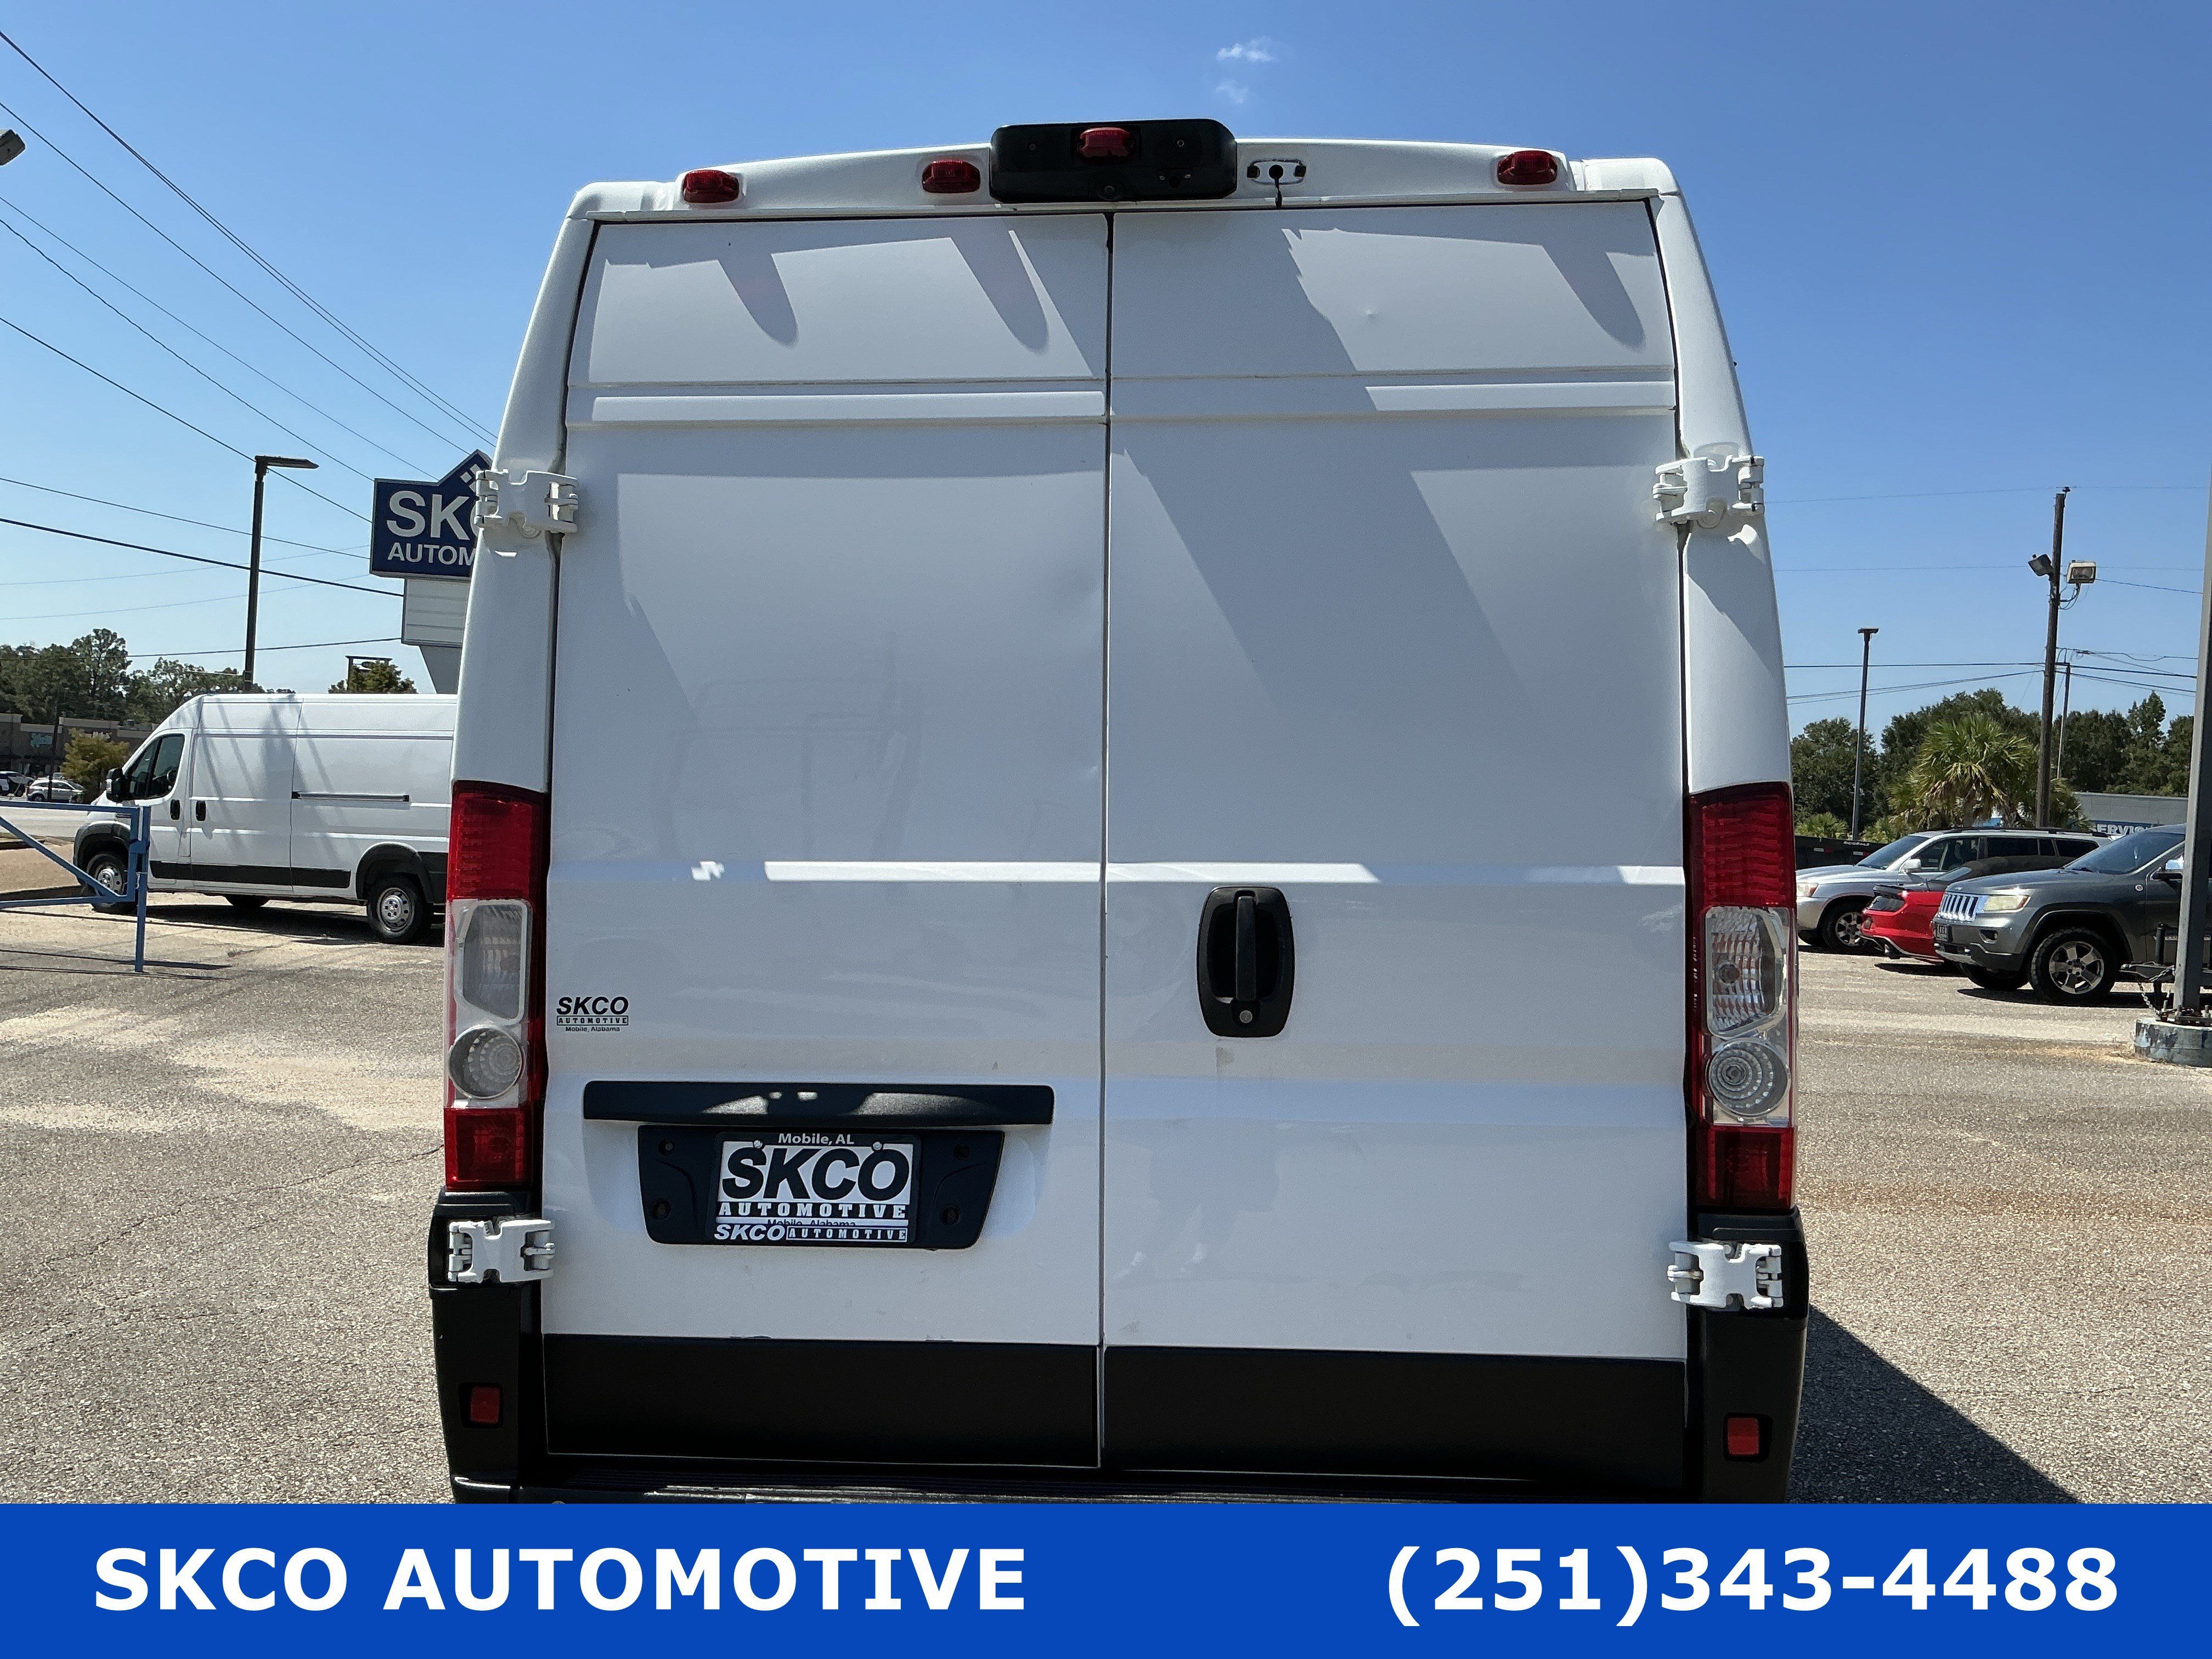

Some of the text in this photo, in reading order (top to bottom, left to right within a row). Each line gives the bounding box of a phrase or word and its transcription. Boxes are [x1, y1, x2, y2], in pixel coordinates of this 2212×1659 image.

[386, 490, 480, 540] SK
[556, 996, 629, 1015] SKCO
[778, 1133, 855, 1146] Mobile, AL
[722, 1146, 910, 1201] SKCO
[718, 1202, 906, 1218] AUTOMOTIVE
[714, 1224, 906, 1240] SKCO AUTOMOTIVE
